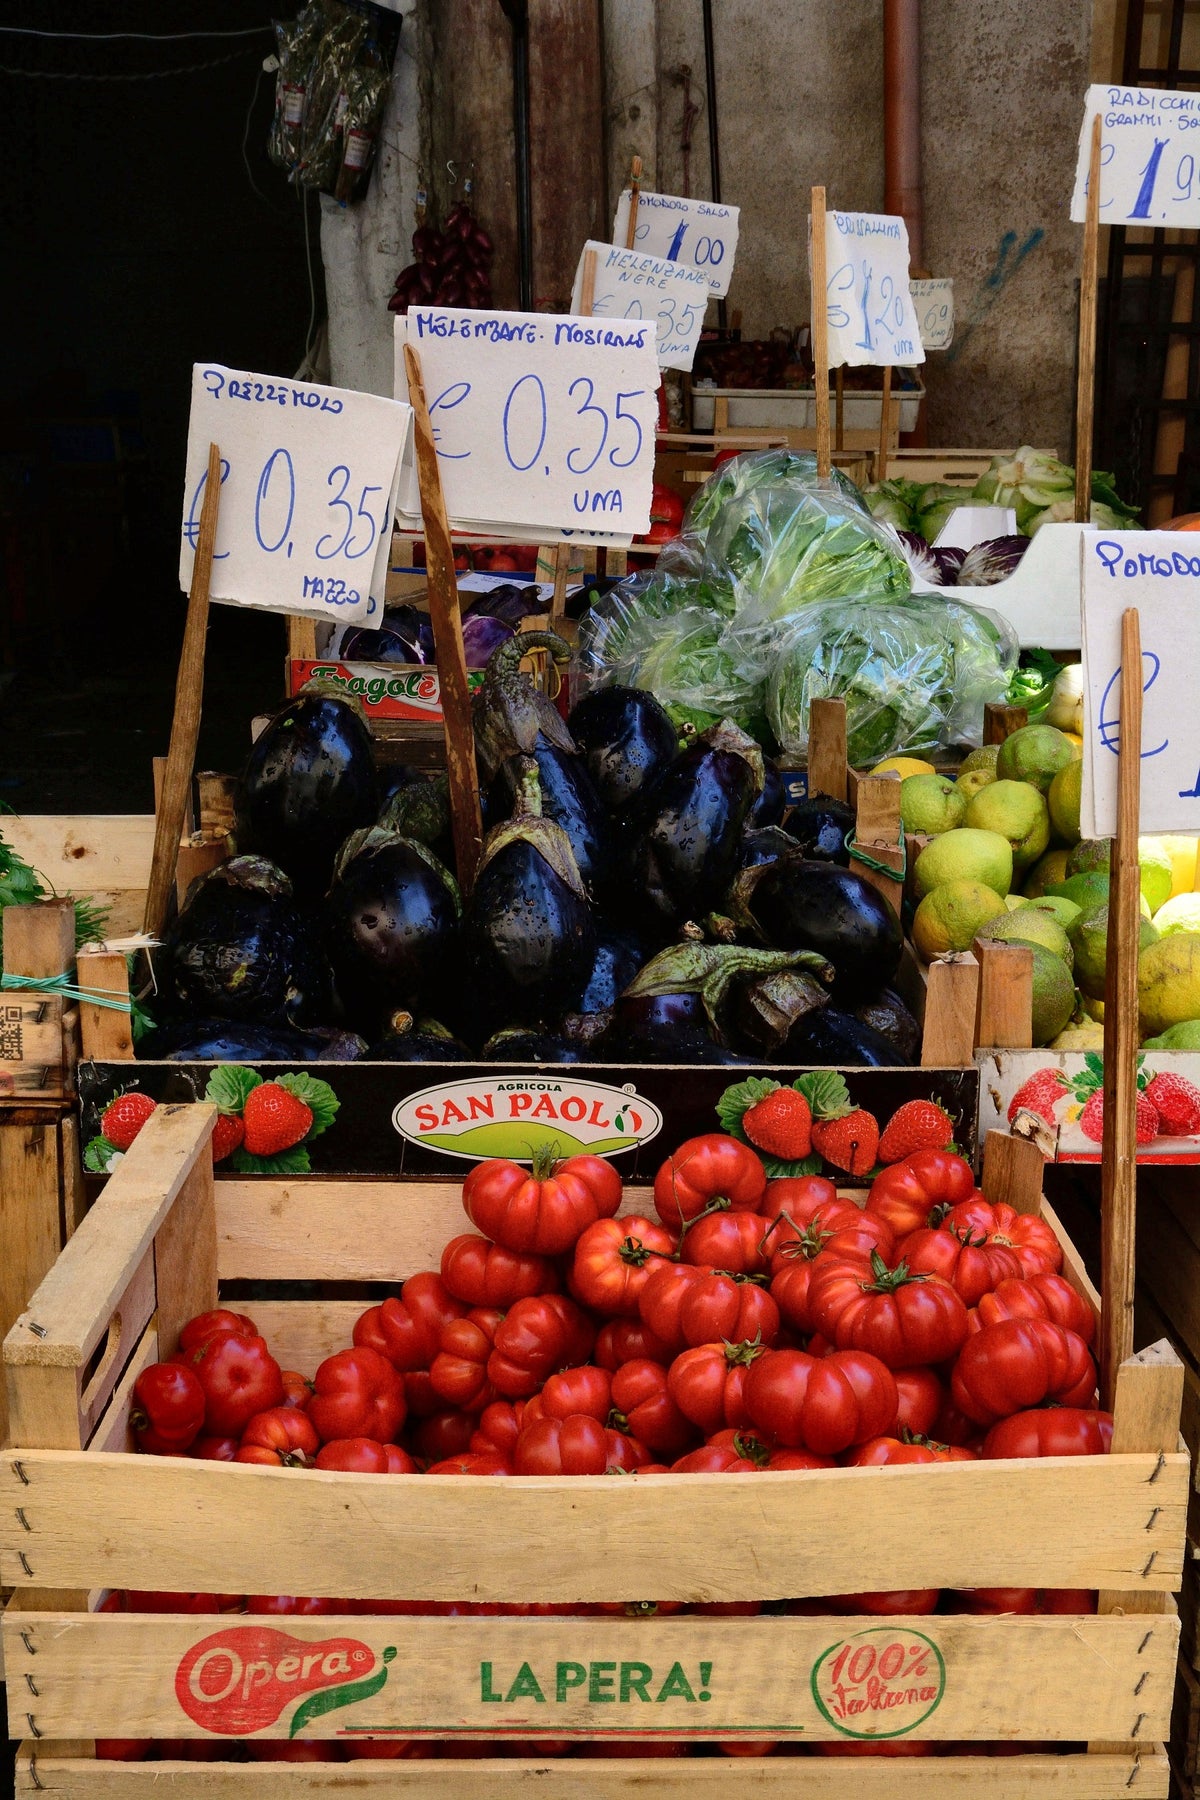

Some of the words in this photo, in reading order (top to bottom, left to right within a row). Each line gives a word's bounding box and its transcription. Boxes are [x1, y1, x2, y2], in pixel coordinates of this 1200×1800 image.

[1105, 112, 1161, 127] GRAMMI
[1126, 137, 1200, 219] 1,9
[697, 205, 729, 217] SALSA
[618, 271, 668, 289] NERE
[660, 343, 690, 353] UNA
[893, 340, 914, 356] UNA
[203, 370, 343, 414] PREZZEMOLO
[503, 373, 645, 475] 0,35
[254, 447, 383, 560] 0,35
[573, 489, 623, 513] UNA
[302, 574, 361, 605] MAZZO
[497, 1083, 562, 1092] AGRICOLA
[414, 1093, 494, 1131] SAN
[189, 1647, 351, 1702] Opera
[828, 1643, 932, 1685] 100%
[480, 1661, 546, 1702] LA
[556, 1661, 713, 1702] PERA!
